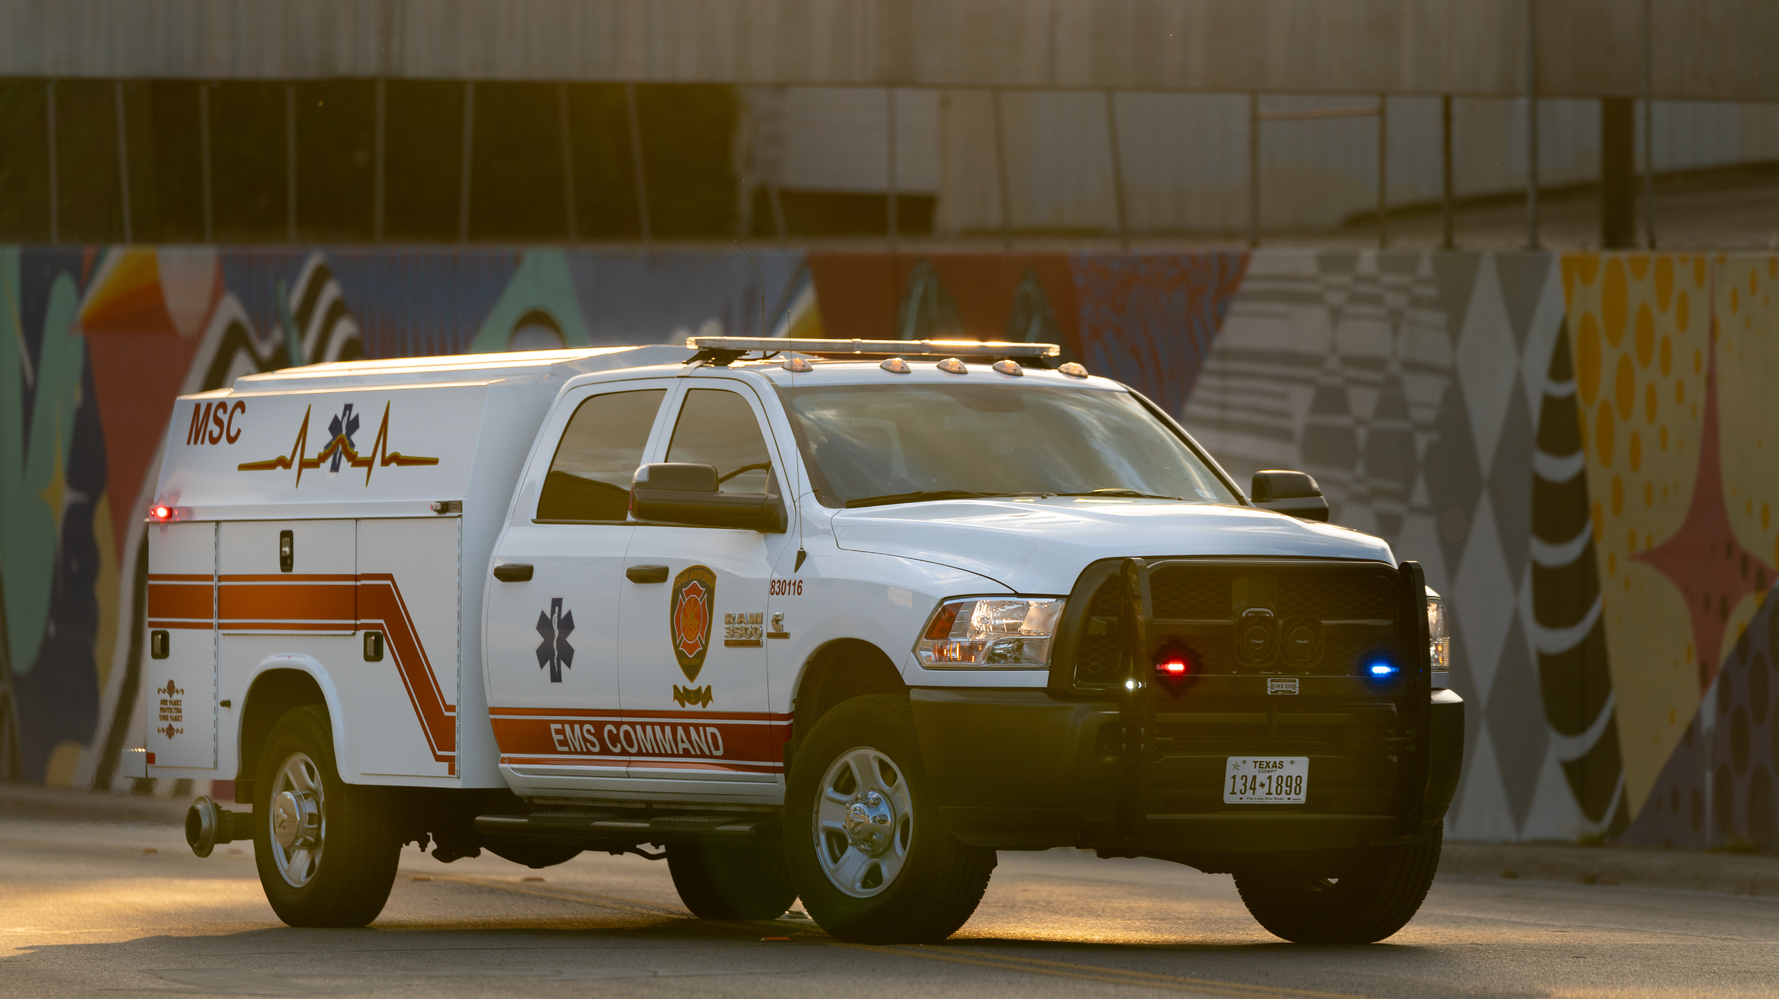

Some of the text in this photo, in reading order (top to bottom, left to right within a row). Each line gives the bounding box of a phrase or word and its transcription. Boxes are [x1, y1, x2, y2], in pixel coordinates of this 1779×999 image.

[187, 400, 246, 446] MSC
[674, 571, 690, 589] SAN
[770, 579, 803, 596] 830116
[724, 611, 763, 625] RAM
[724, 625, 763, 639] 3500
[550, 723, 724, 756] EMS COMMAND
[1252, 760, 1284, 769] TEXAS
[1229, 774, 1303, 796] 134 1898
